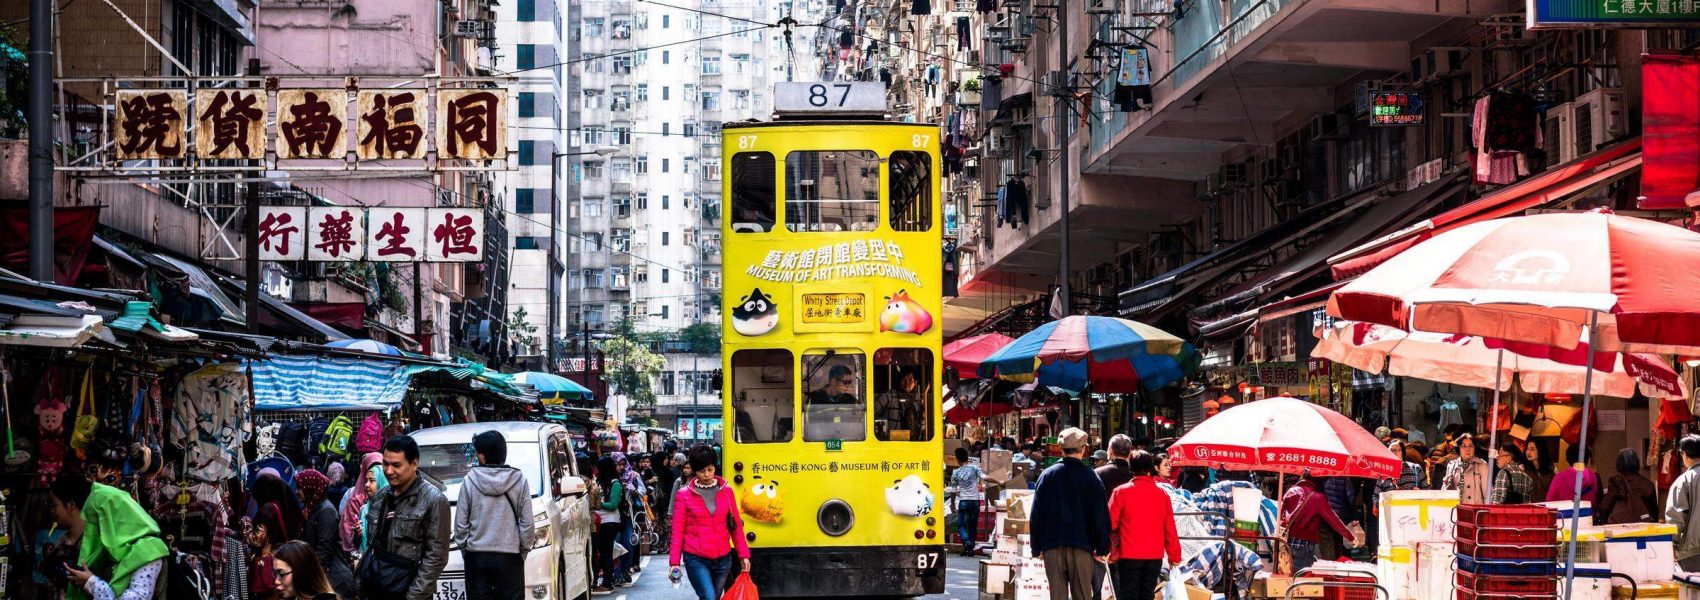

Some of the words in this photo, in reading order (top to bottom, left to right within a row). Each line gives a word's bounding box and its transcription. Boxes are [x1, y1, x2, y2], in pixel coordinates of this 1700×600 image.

[808, 84, 852, 107] 87
[738, 134, 757, 149] 87
[912, 134, 930, 148] 87
[762, 239, 904, 270] 藝術館閉館變型中
[746, 264, 794, 282] MUSEUM
[795, 270, 810, 282] OF
[812, 267, 834, 281] ART
[836, 264, 922, 288] TRANSFORMING
[805, 295, 823, 307] Whitty
[825, 295, 844, 305] Street
[845, 296, 863, 307] Depot
[827, 441, 840, 449] 054
[752, 462, 761, 474] 香
[762, 463, 788, 472] HONG
[789, 462, 799, 474] 港
[801, 463, 827, 471] KONG
[829, 461, 839, 473] 藝
[841, 463, 879, 471] MUSEUM
[881, 460, 890, 473] 術
[892, 462, 902, 470] OF
[905, 462, 919, 470] ART
[921, 460, 930, 472] 館
[1279, 453, 1305, 463] 2681
[1309, 455, 1337, 467] 8888
[918, 553, 938, 569] 87
[441, 582, 458, 591] SL
